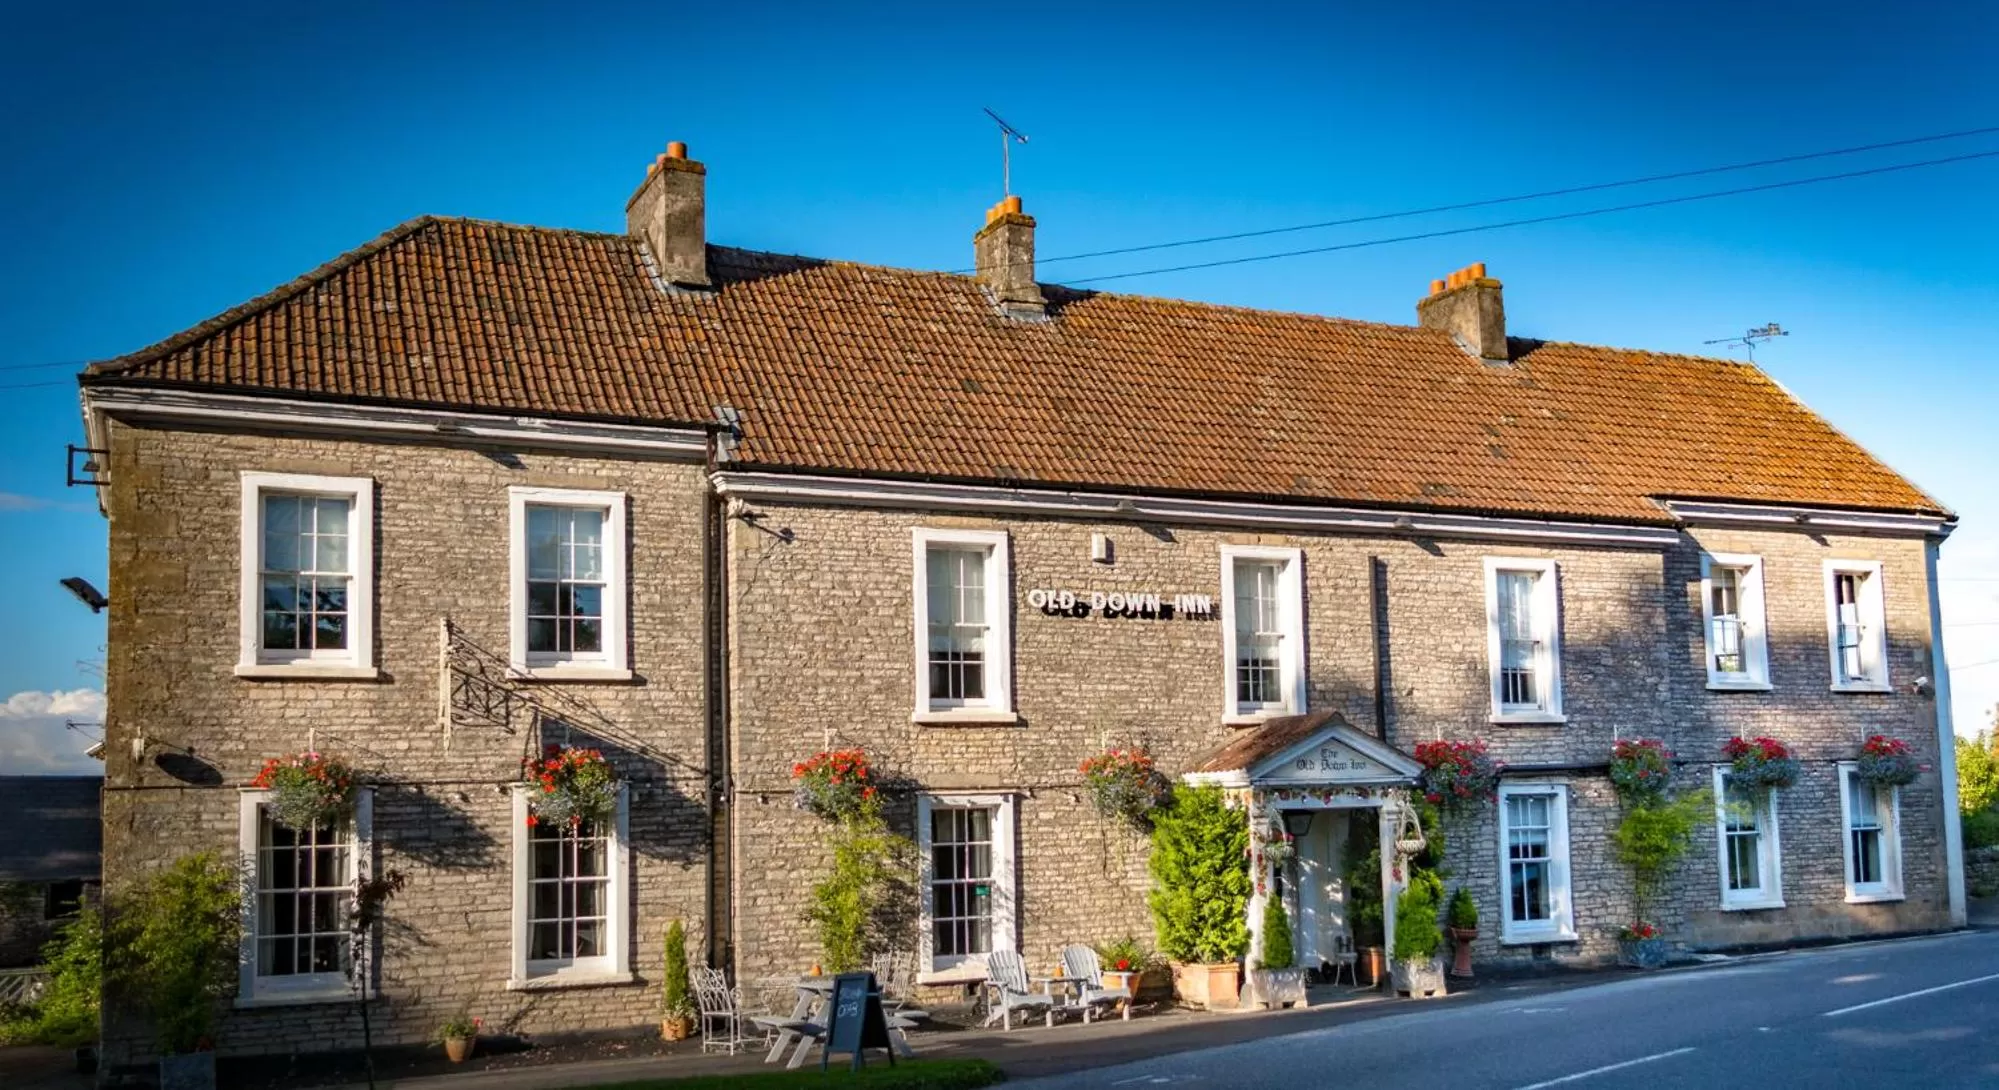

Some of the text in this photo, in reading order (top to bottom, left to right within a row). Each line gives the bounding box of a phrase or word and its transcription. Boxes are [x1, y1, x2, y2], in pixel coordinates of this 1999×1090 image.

[1028, 589, 1211, 613] OLD DOWN INN
[1321, 748, 1338, 759] The
[1296, 758, 1366, 773] Old Down Inn
